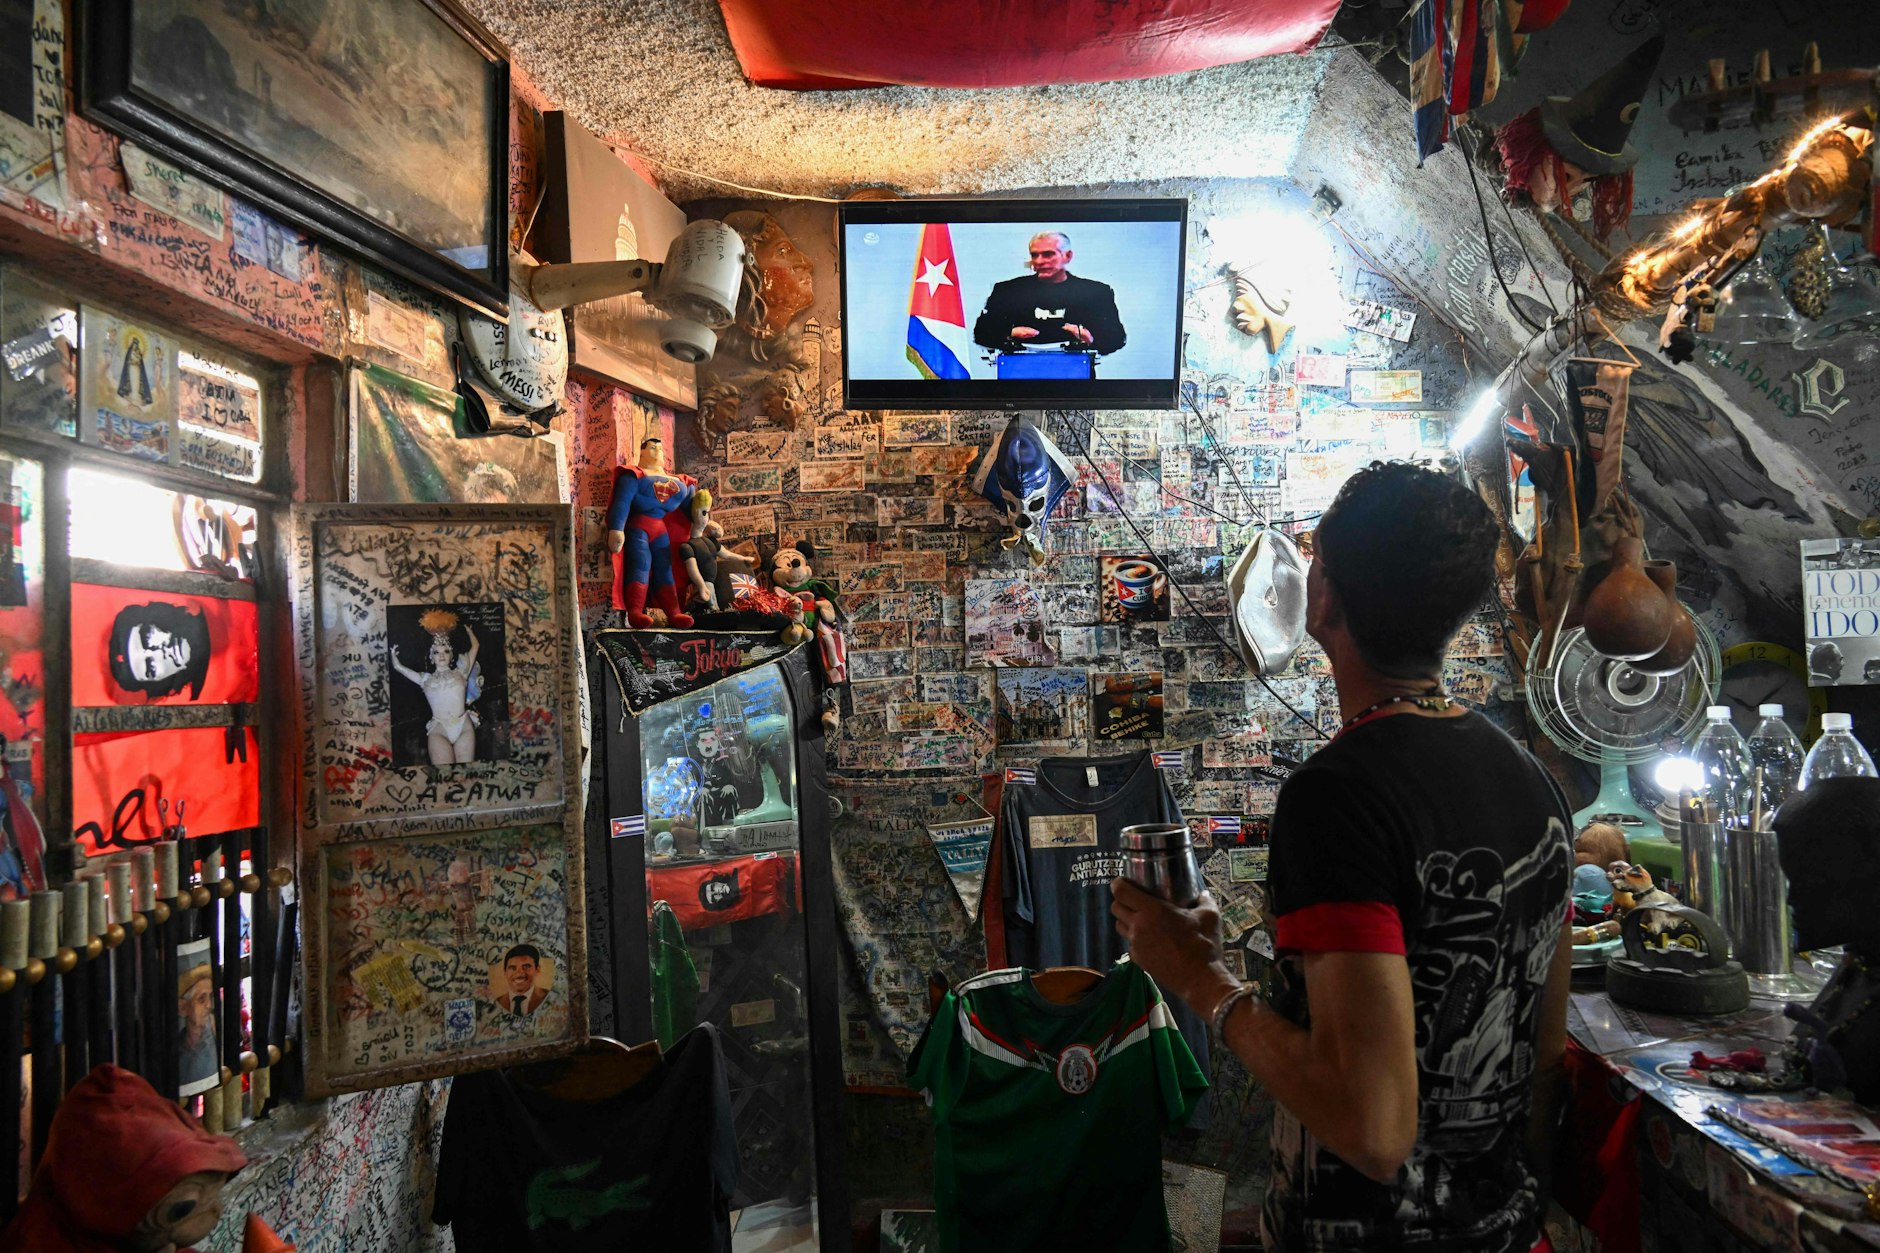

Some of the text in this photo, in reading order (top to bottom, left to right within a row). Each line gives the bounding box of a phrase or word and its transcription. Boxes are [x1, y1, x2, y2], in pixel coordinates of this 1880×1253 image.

[499, 370, 535, 399] MESSI
[1576, 387, 1614, 406] OSTOCK
[861, 432, 876, 442] FER
[679, 638, 742, 681] Tokyo
[1026, 655, 1047, 663] CUBA
[1750, 646, 1767, 659] 12
[1099, 711, 1150, 735] COHIBA
[1110, 720, 1150, 740] BEHIKE
[1071, 858, 1124, 873] GURUTZETA
[1069, 867, 1125, 882] ANTIFAXIST
